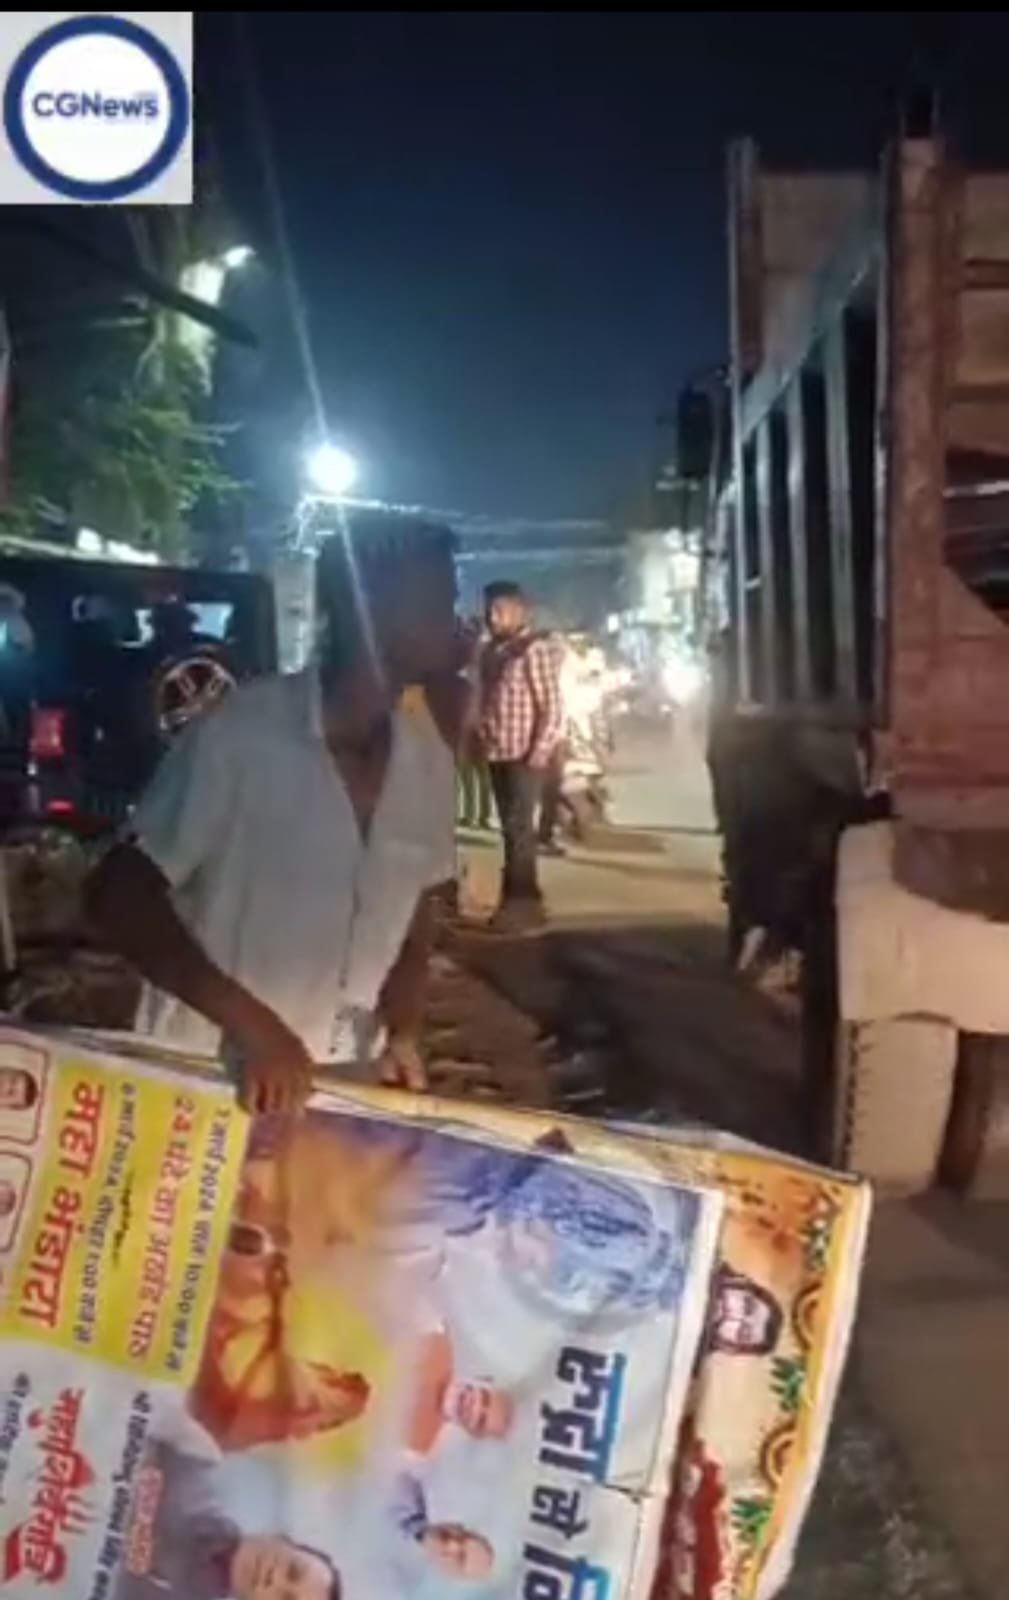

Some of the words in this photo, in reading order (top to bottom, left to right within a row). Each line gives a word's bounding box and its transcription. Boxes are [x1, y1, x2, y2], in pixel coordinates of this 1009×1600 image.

[59, 1081, 105, 1178] महा
[172, 1096, 195, 1131] 24
[150, 1186, 178, 1225] का
[19, 1185, 85, 1328] भंडारा
[128, 1311, 158, 1357] पाठ
[529, 1485, 589, 1540] से
